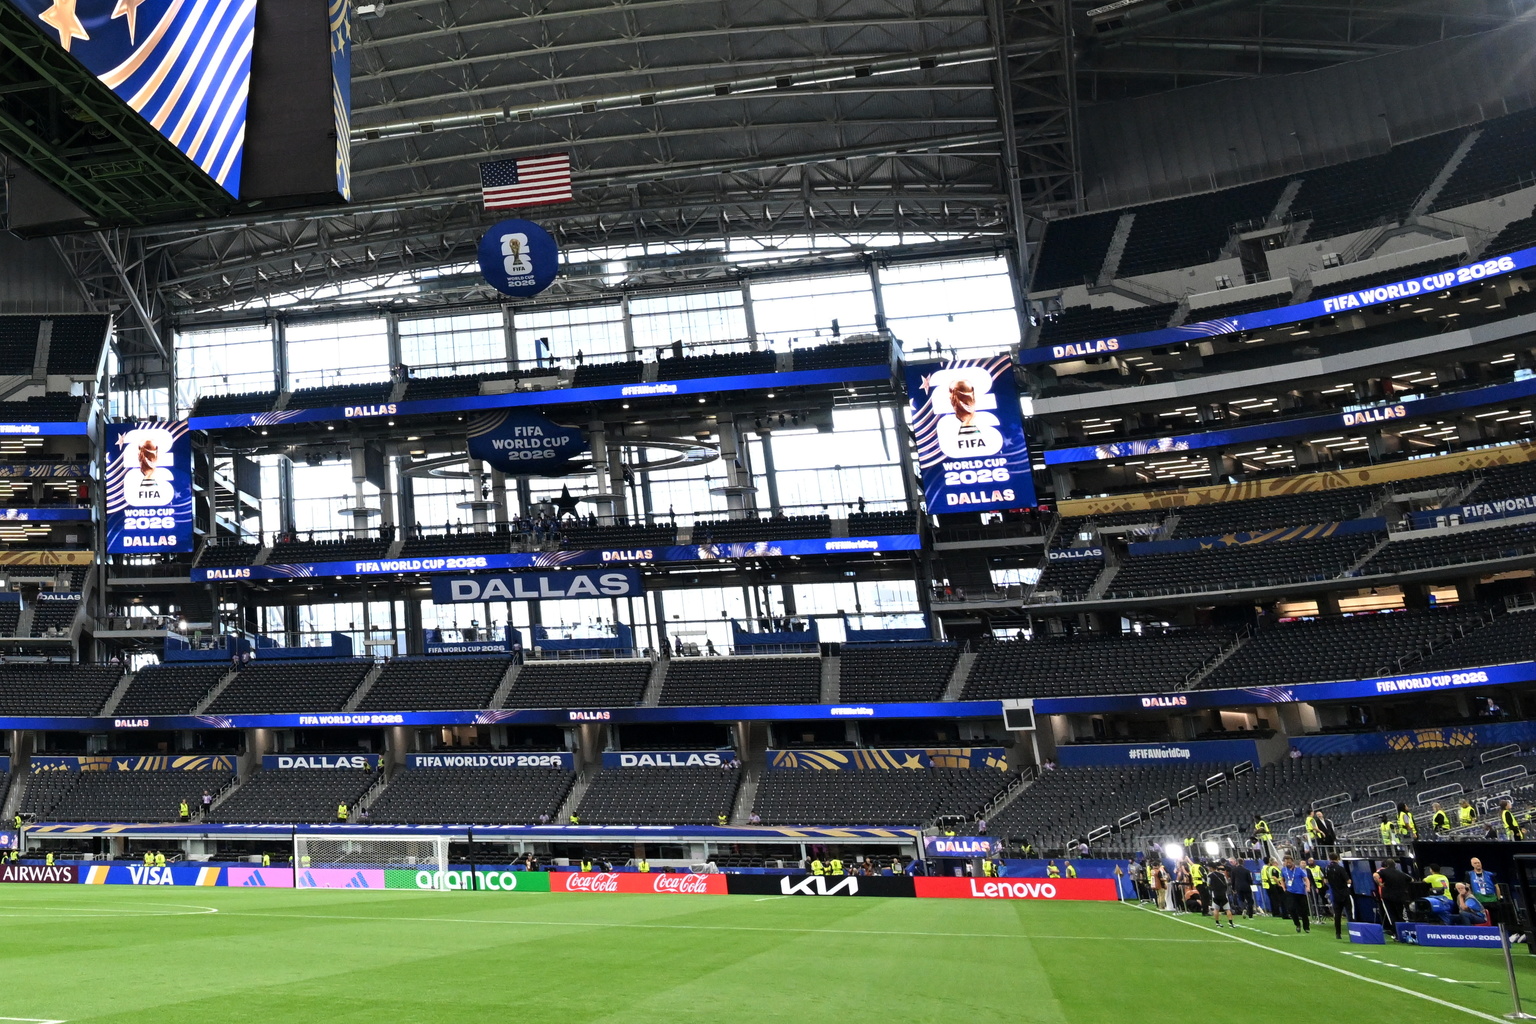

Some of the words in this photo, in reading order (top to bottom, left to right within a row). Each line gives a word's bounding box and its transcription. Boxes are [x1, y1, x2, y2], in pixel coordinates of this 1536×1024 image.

[1324, 296, 1359, 312] FIFA
[1359, 282, 1420, 304] WORLD
[1423, 274, 1457, 291] CUP
[1457, 257, 1513, 283] 2026
[1053, 339, 1119, 358] DALLAS
[345, 404, 397, 418] DALLAS
[1344, 406, 1406, 426] DALLAS
[515, 426, 543, 437] FIFA
[492, 438, 541, 449] WORLD
[543, 436, 570, 447] CUP
[958, 438, 986, 449] FIFA
[508, 449, 556, 461] 2026
[943, 459, 982, 471] WORLD
[984, 458, 1006, 468] CUP
[944, 468, 1010, 485] 2026
[946, 489, 1015, 506] DALLAS
[1464, 504, 1493, 517] FIFA
[1492, 496, 1536, 512] WORL
[124, 517, 175, 529] 2026
[124, 535, 176, 546] DALLAS
[602, 549, 653, 561] DALLAS
[1050, 548, 1102, 560] DALLAS
[356, 562, 379, 573] FIFA
[380, 560, 420, 572] WORLD
[423, 560, 445, 570] CUP
[446, 558, 487, 568] 2026
[207, 568, 250, 579] DALLAS
[451, 573, 630, 600] DALLAS
[428, 645, 442, 653] FIFA
[443, 645, 466, 653] WORLD
[481, 644, 505, 652] 2026
[1377, 681, 1396, 692] FIFA
[1397, 678, 1431, 690] WORLD
[1432, 676, 1451, 687] CUP
[1452, 672, 1488, 684] 2026
[1142, 695, 1187, 707] DALLAS
[570, 711, 610, 720] DALLAS
[621, 754, 720, 766] DALLAS
[1129, 747, 1190, 760] #FIFAWorldCup
[278, 756, 364, 768] DALLAS
[416, 757, 442, 767] FIFA
[444, 756, 489, 767] WORLD
[491, 756, 515, 766] CUP
[517, 755, 562, 766] 2026
[936, 840, 990, 852] DALLAS
[3, 866, 72, 882] AIRWAYS
[126, 866, 174, 884] VISA
[416, 870, 516, 890] aramco
[566, 873, 619, 892] Coca-Cola
[654, 873, 708, 892] Coca-Cola
[971, 879, 1056, 898] Lenovo
